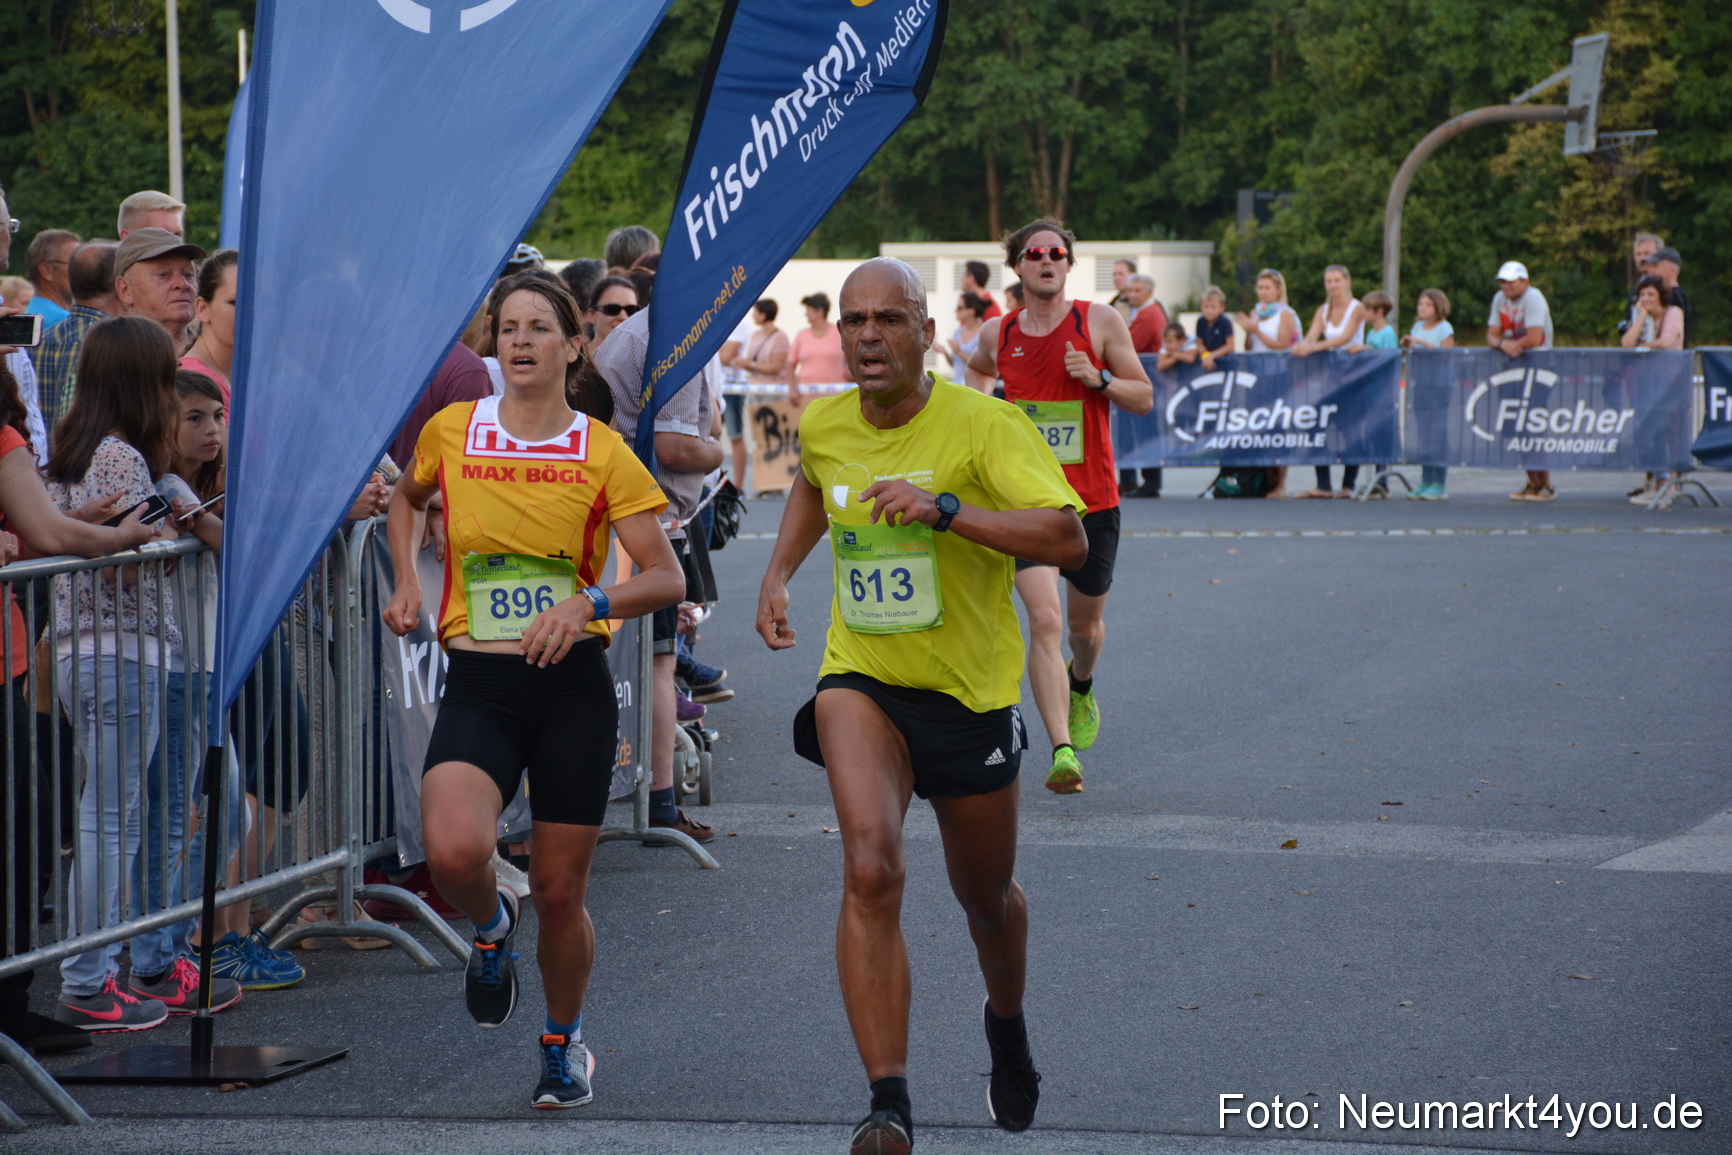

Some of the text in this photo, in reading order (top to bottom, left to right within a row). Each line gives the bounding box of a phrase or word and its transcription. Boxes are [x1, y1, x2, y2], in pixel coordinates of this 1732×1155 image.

[799, 97, 845, 162] Druck
[876, 0, 931, 77] Medien
[684, 21, 867, 261] Frischmann
[1195, 399, 1338, 433] Fischer
[1495, 399, 1635, 433] Fischer
[1204, 433, 1326, 449] AUTOMOBILE
[1507, 437, 1618, 453] AUTOMOBILE
[462, 464, 588, 484] MAX BÖGL
[490, 585, 554, 619] 896
[850, 567, 914, 603] 613
[885, 610, 918, 618] Niebauer
[985, 757, 1006, 766] adidas
